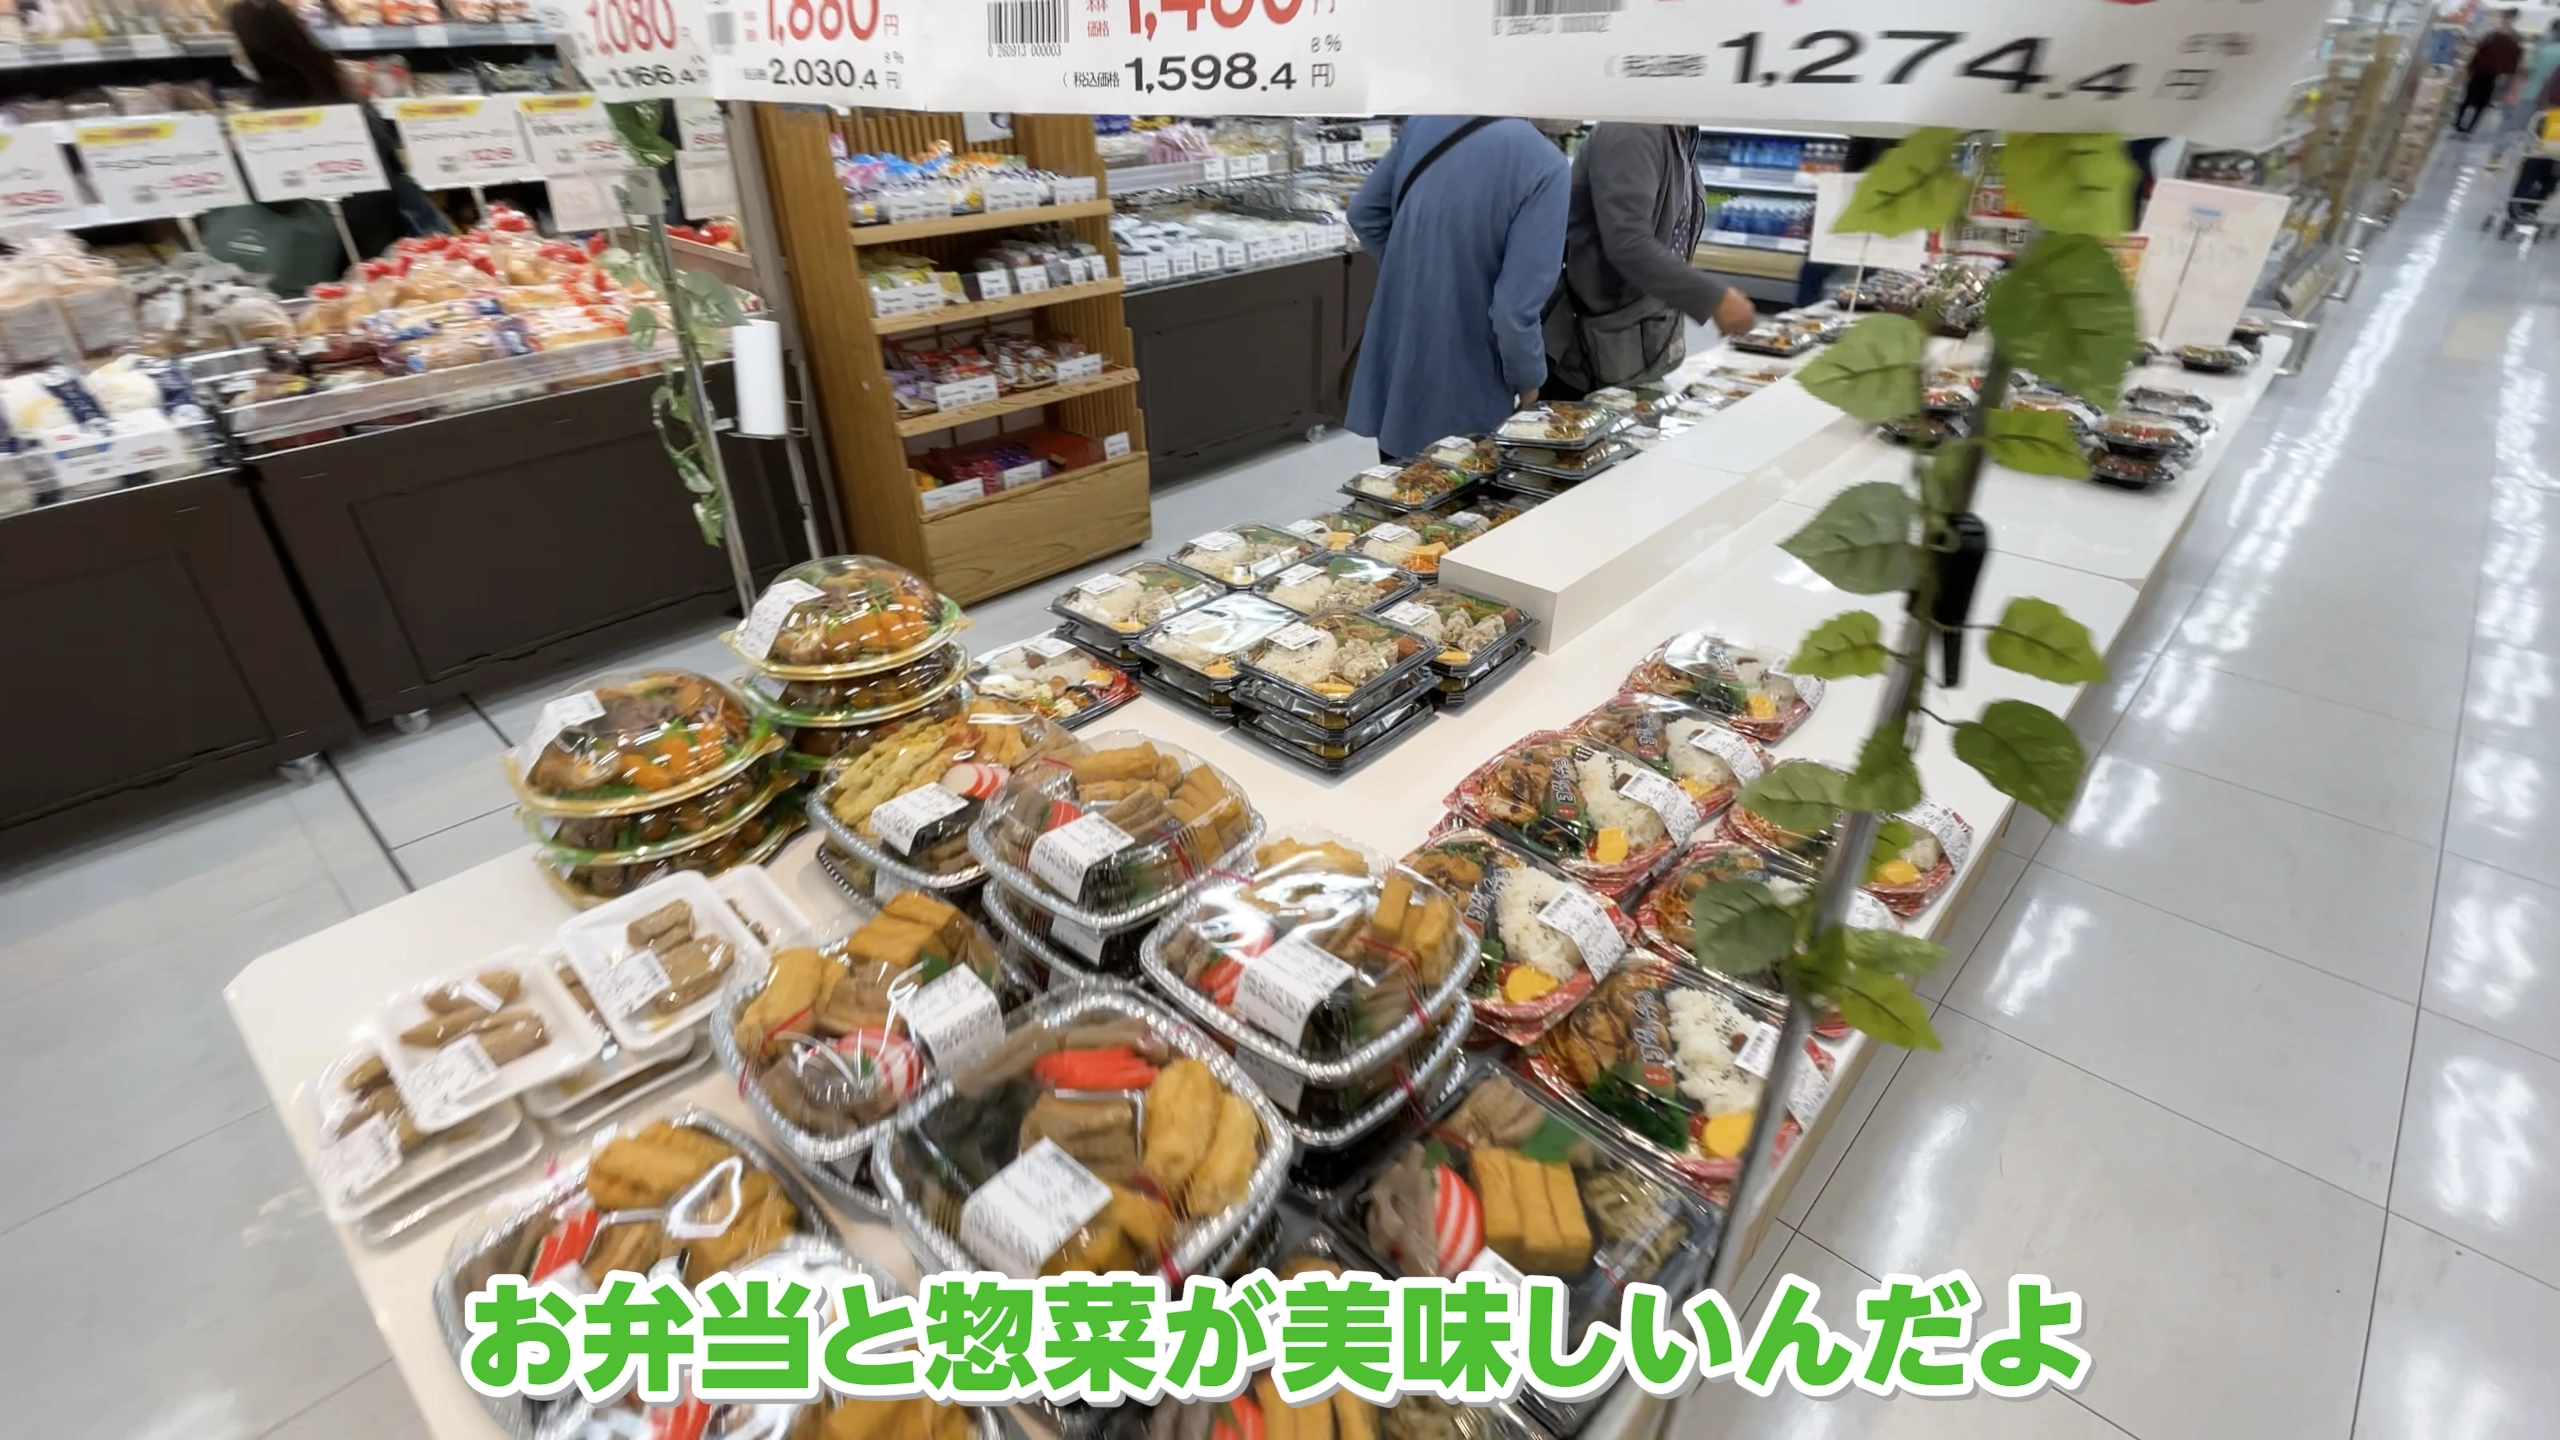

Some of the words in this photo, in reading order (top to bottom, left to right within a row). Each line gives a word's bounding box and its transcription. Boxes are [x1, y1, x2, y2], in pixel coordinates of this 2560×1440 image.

[769, 58, 878, 90] 2,030.4
[1124, 52, 1297, 94] 1,598.4
[1717, 31, 2138, 100] 1,274.4
